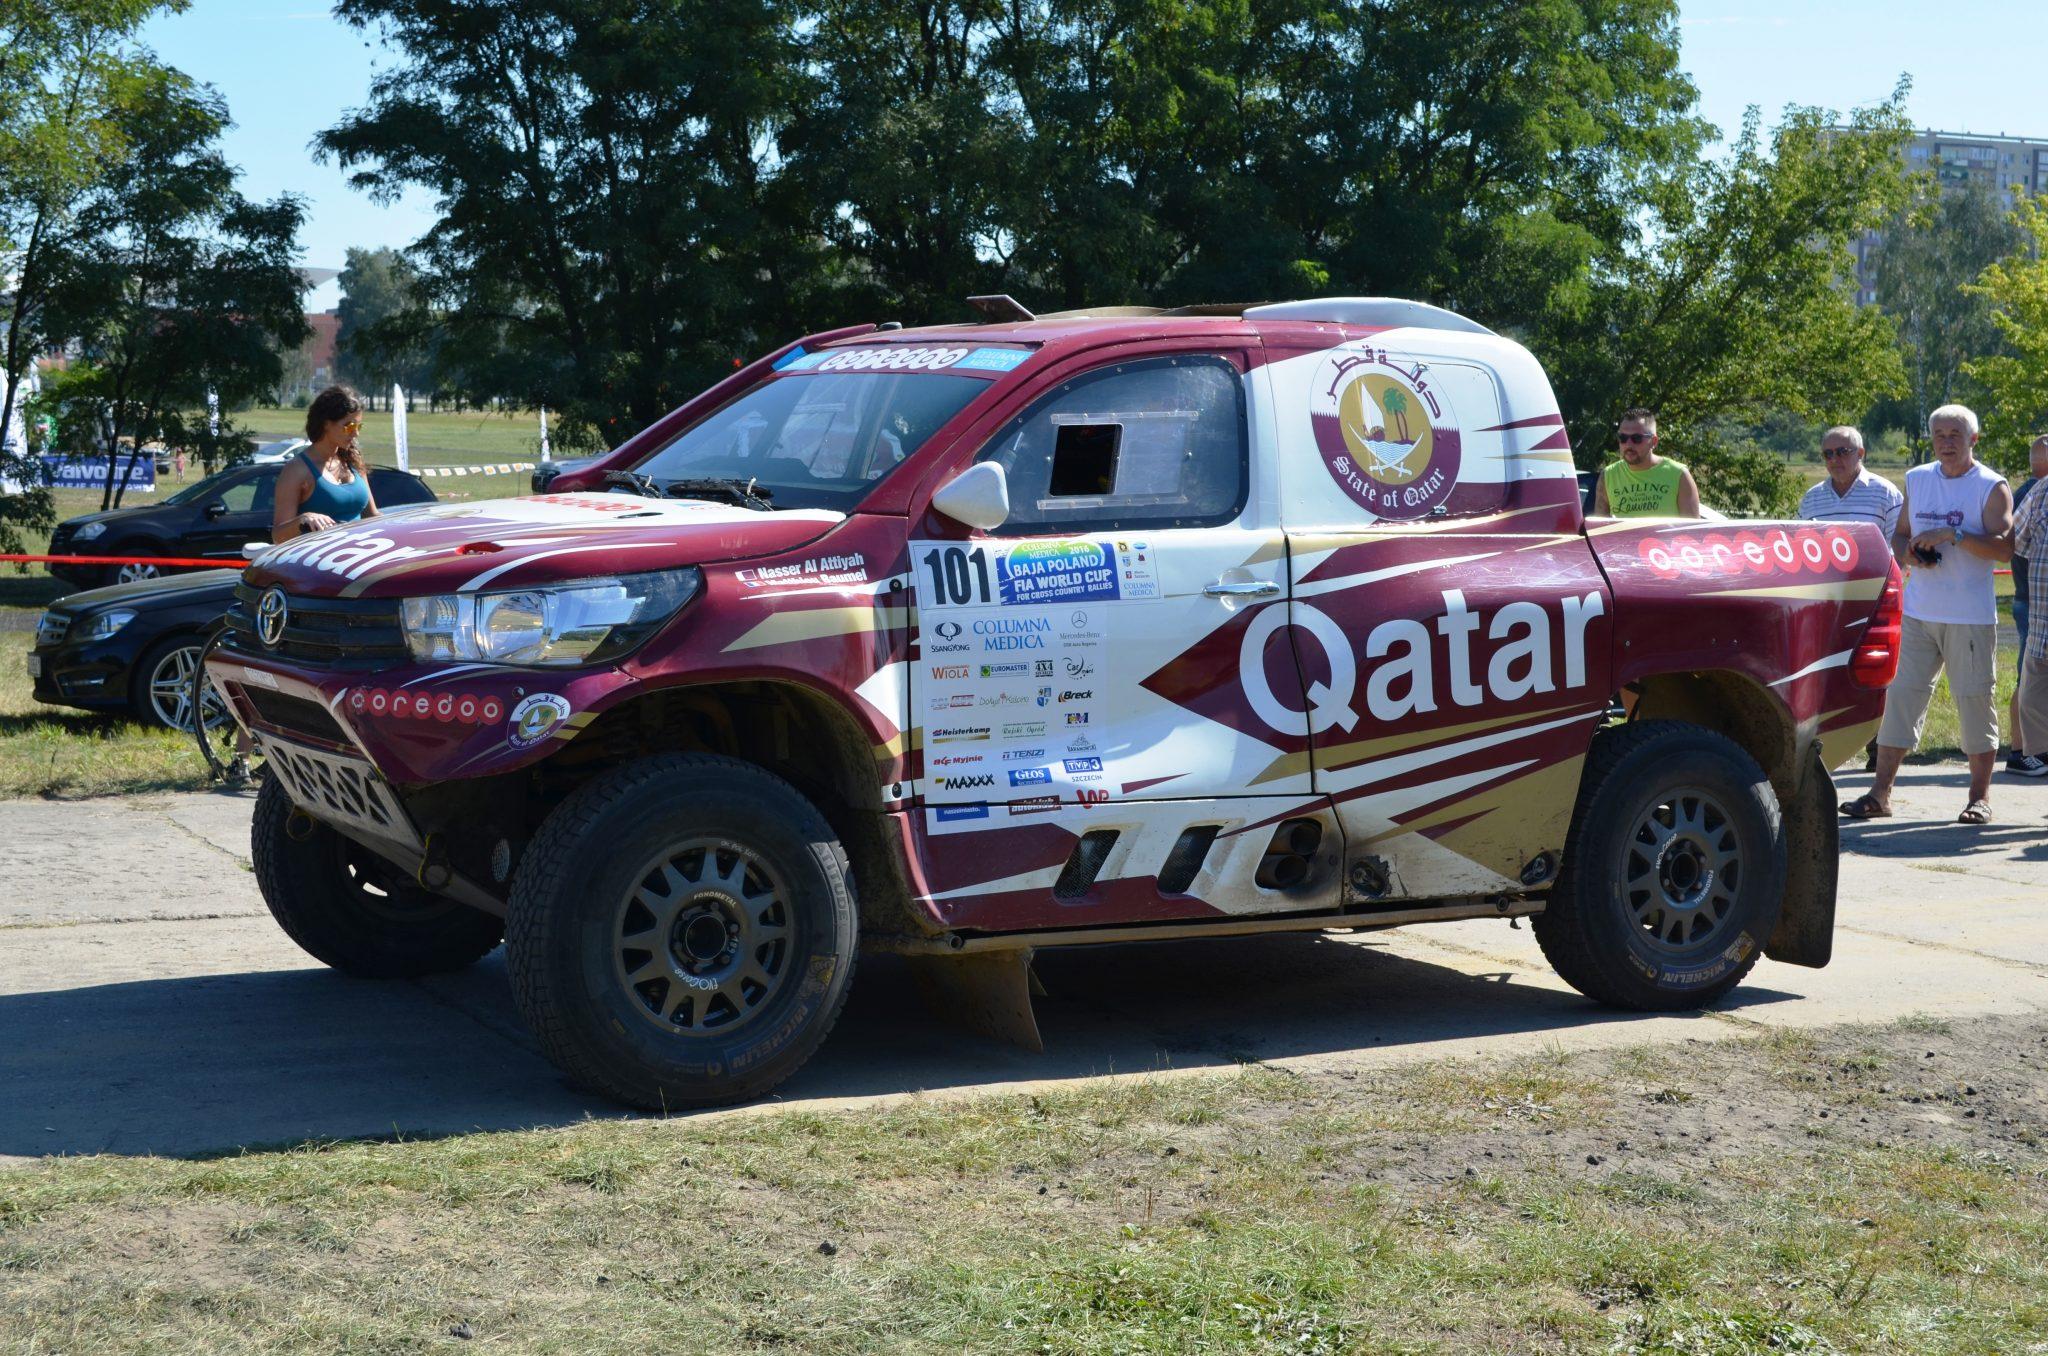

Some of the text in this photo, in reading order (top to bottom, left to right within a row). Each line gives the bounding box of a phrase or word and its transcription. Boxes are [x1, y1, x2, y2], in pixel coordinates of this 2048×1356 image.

[1333, 456, 1445, 508] State of Qatar
[1613, 483, 1669, 496] SAILING
[1648, 531, 1851, 571] ooredoo
[757, 553, 864, 579] Nasser Al Attiyah
[1013, 555, 1099, 577] BAJA POLAND
[924, 547, 991, 605] 101
[1014, 569, 1113, 593] FIA WORLD CUP
[1016, 582, 1113, 602] FOR CROSS COUNTRY RALLIES
[973, 617, 1052, 635] COLUMNA
[931, 643, 971, 653] SSANGYONG
[985, 635, 1045, 651] MEDICA
[991, 664, 1028, 673] EUROMASTER
[1066, 663, 1080, 672] Car
[1239, 588, 1605, 736] Qatar
[932, 667, 969, 680] WIOLA
[1064, 690, 1094, 700] Breck
[351, 692, 499, 719] ooredoo
[942, 727, 990, 736] Heisterkamp
[953, 755, 983, 764] Myjnie
[1013, 749, 1045, 758] TENZI
[1067, 762, 1089, 771] TVP
[944, 772, 995, 790] MAXXX
[693, 891, 737, 909] FONDMETAL
